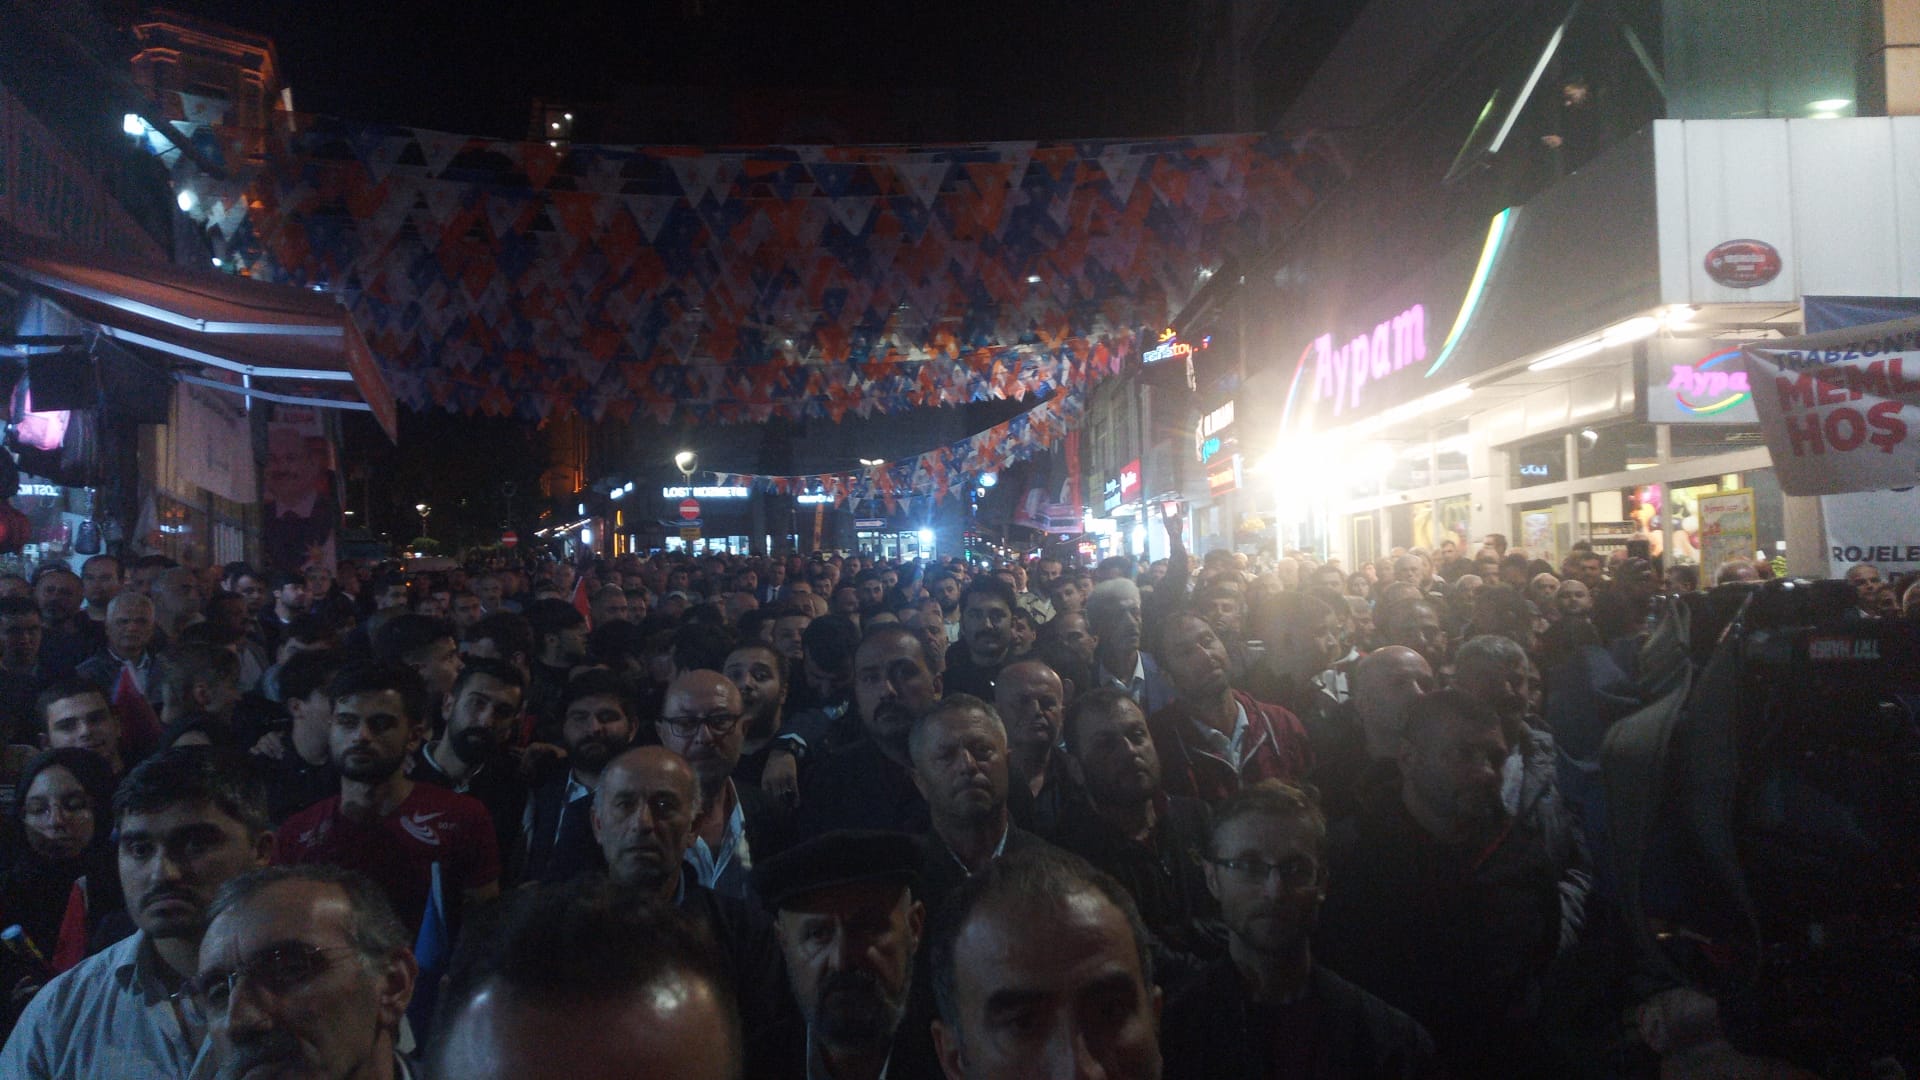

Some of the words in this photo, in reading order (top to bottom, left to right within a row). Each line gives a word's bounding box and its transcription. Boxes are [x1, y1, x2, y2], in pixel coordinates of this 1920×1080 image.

[1314, 304, 1427, 416] Aypam
[1786, 401, 1907, 457] HOŞ
[1832, 546, 1920, 562] ROJELE
